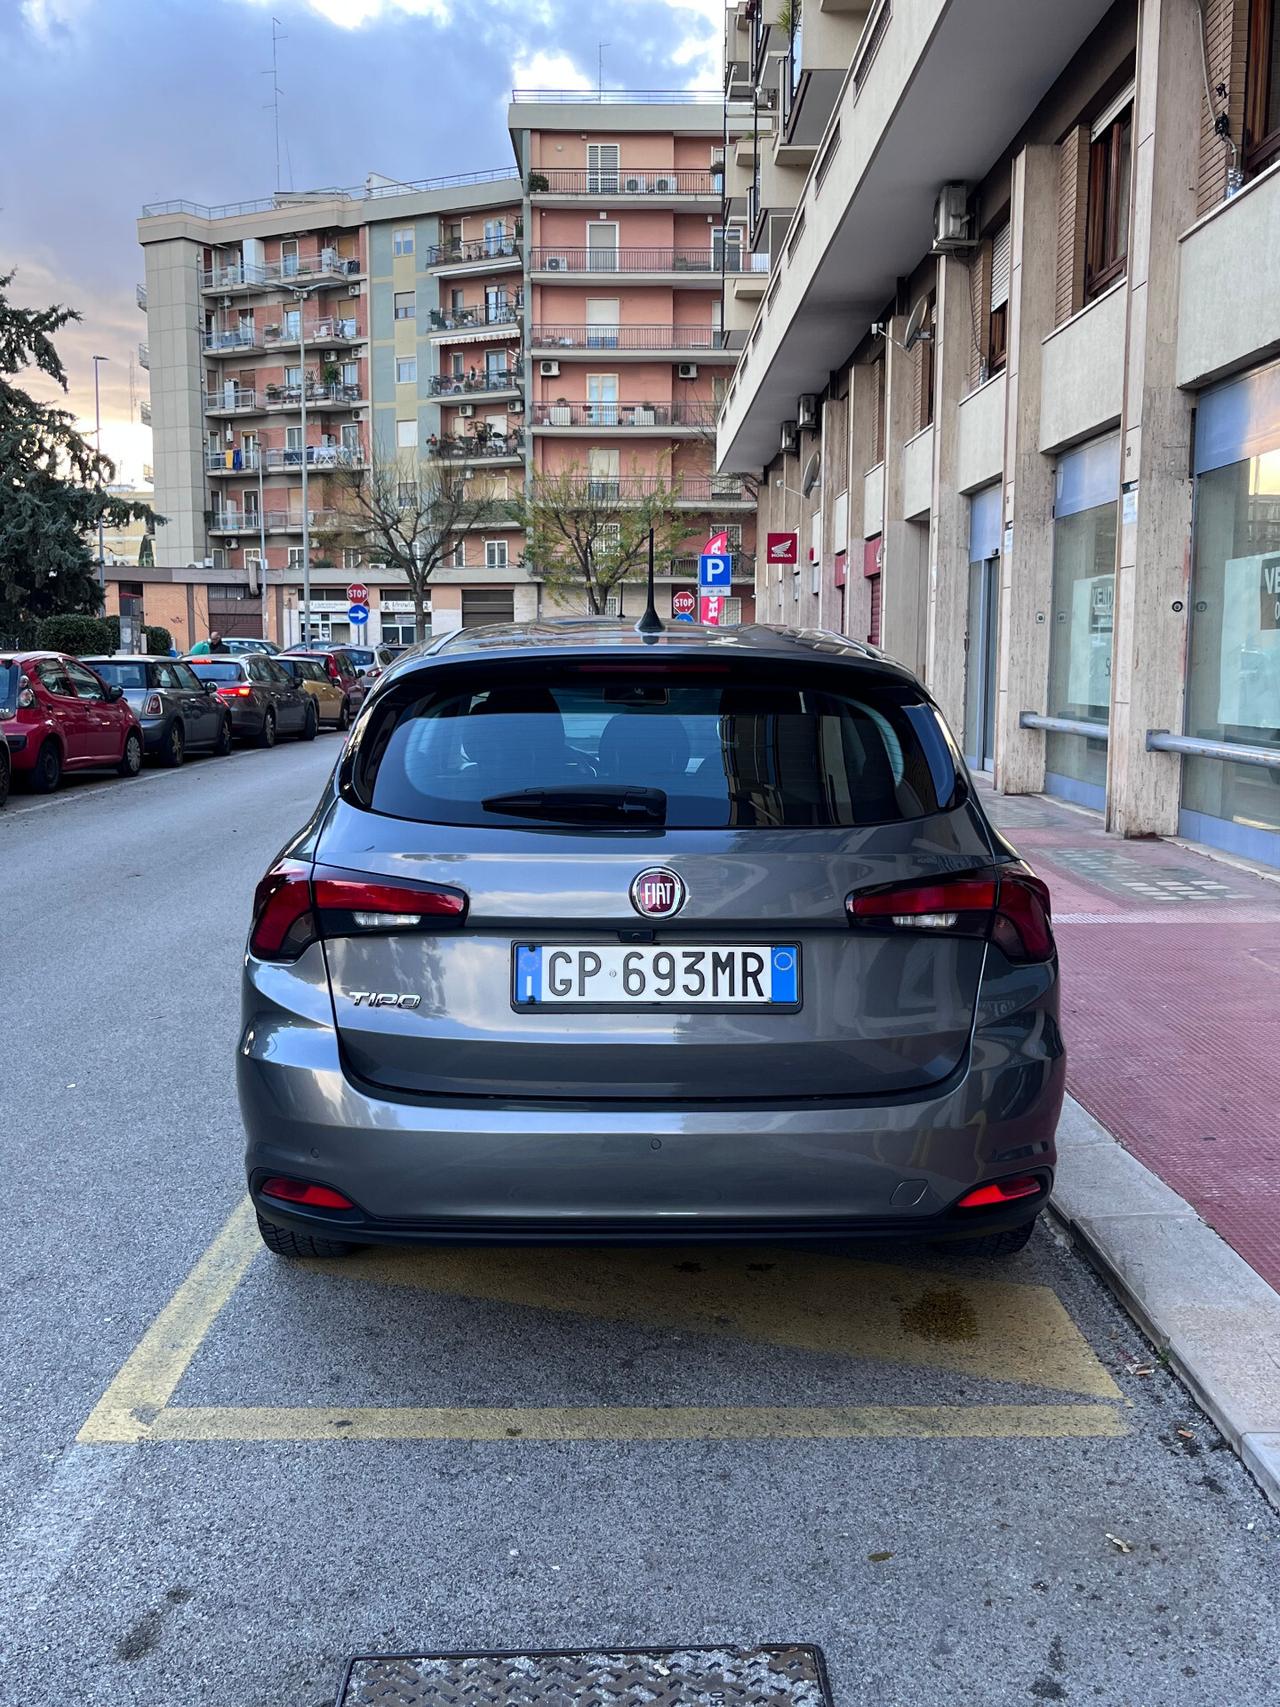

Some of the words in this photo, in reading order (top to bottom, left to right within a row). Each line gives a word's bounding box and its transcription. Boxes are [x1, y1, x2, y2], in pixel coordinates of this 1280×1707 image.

[707, 559, 724, 582] P
[348, 589, 367, 598] STOP
[675, 599, 693, 608] STOP
[644, 883, 673, 905] FIAT
[548, 951, 602, 997] GP
[622, 951, 765, 997] 693MR
[349, 991, 421, 1009] TIPO
